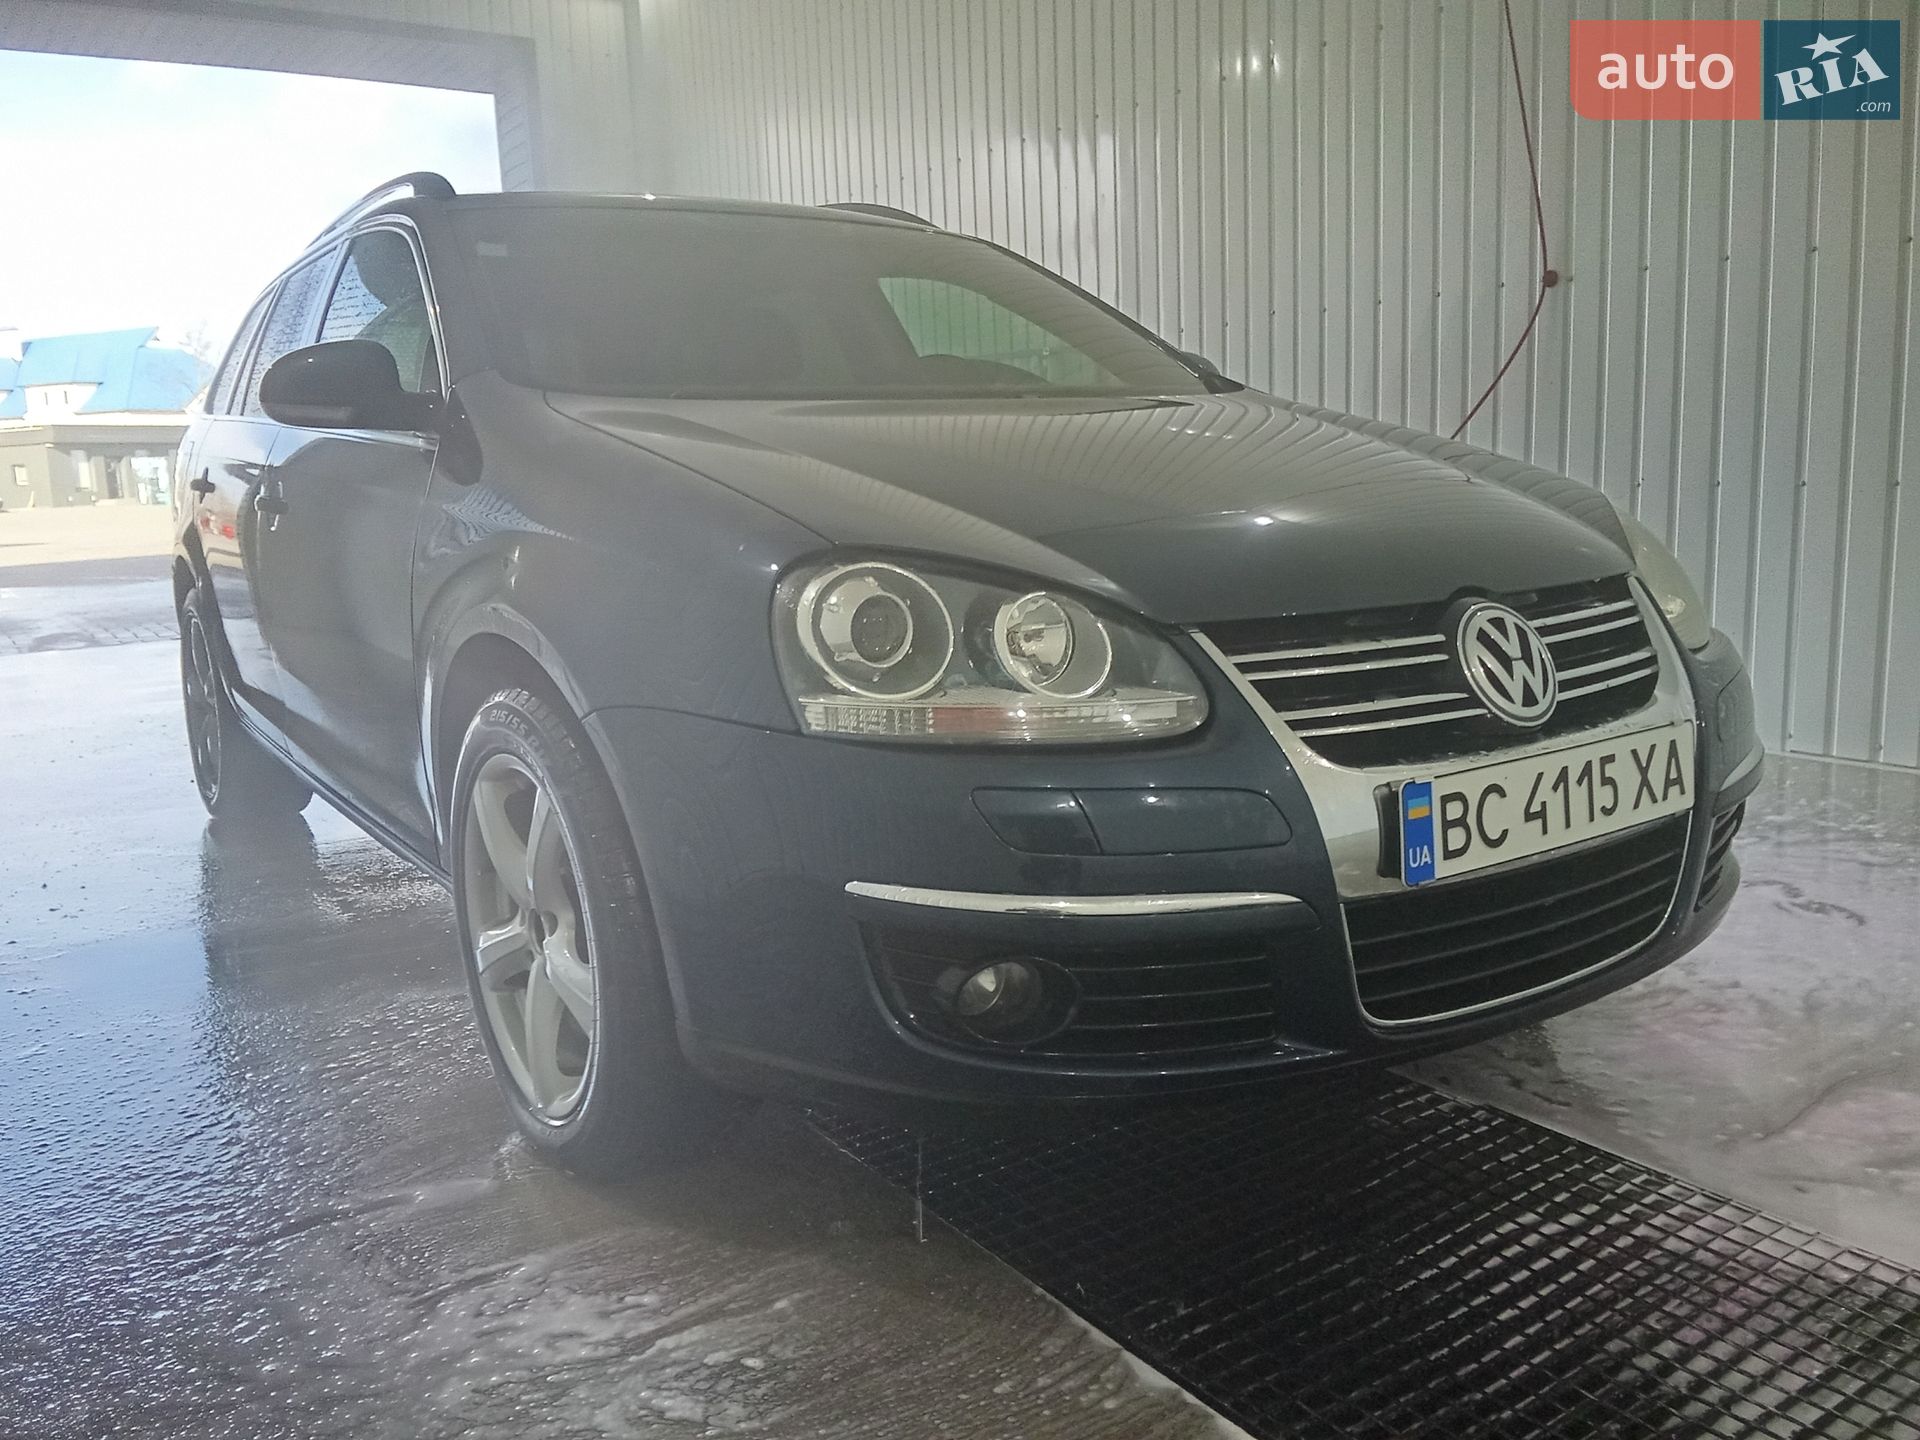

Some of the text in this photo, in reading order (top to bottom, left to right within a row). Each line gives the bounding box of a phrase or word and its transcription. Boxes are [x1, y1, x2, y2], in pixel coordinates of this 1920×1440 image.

[1439, 738, 1686, 861] BC 4115 XA
[1408, 845, 1432, 868] UA
